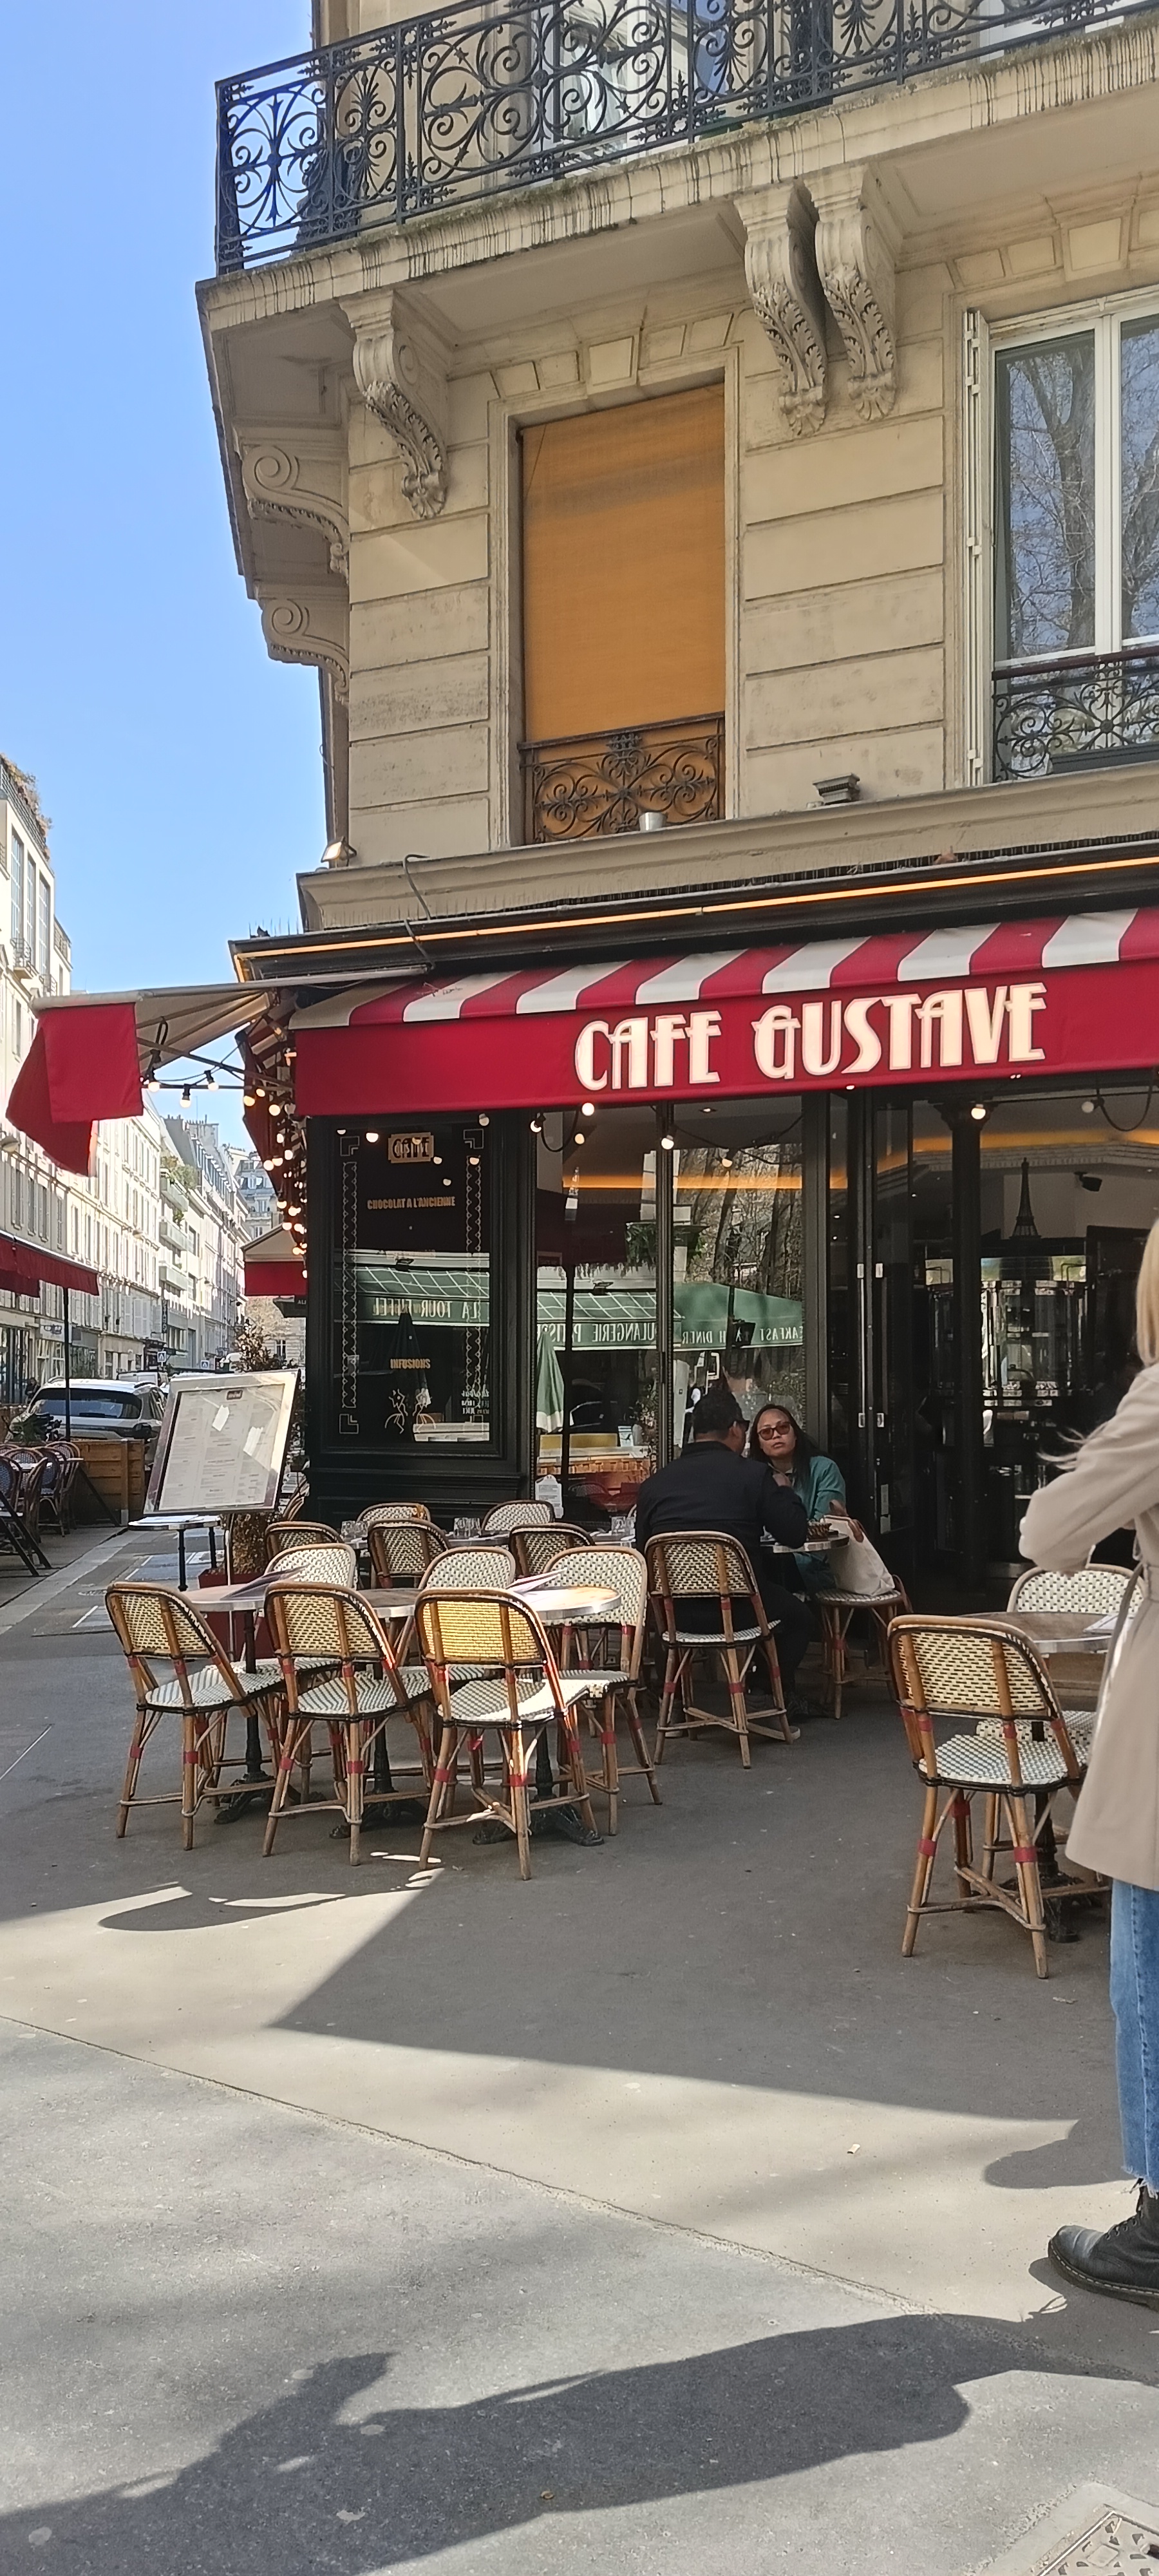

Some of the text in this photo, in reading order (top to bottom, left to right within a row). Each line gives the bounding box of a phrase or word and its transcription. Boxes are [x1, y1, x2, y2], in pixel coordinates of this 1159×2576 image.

[575, 982, 1048, 1091] CAFE GUSTAVE
[367, 1198, 406, 1209] CHOCOLAT
[413, 1196, 455, 1208] L'ANCIENNE
[390, 1358, 431, 1369] INFUSIONS
